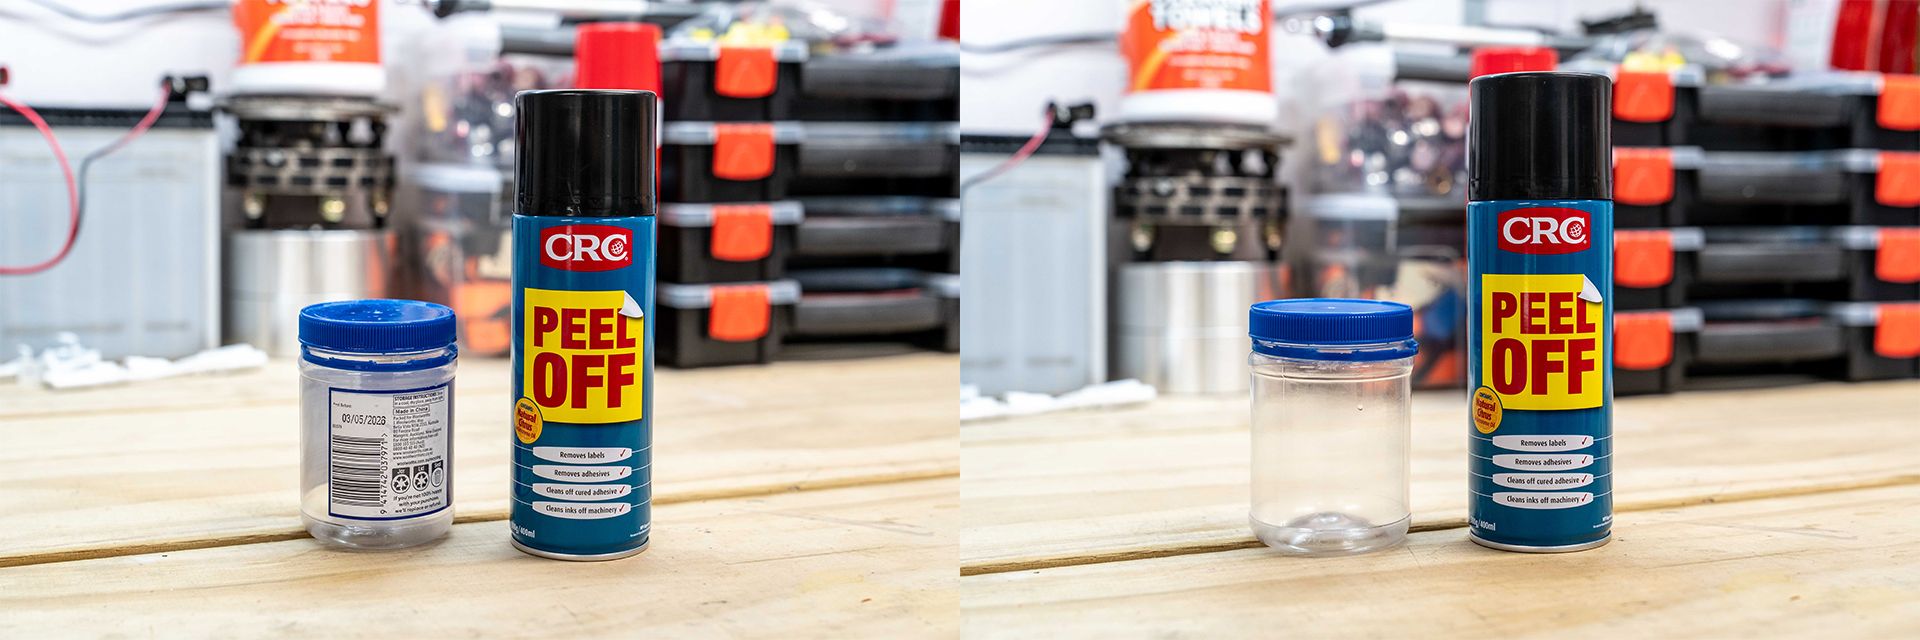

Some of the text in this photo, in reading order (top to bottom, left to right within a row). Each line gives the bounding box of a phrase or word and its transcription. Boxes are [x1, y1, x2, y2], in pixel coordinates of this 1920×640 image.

[1503, 216, 1586, 245] CRC
[545, 233, 628, 262] CRC
[1492, 291, 1596, 335] PEEL
[534, 305, 636, 350] PEEL
[1492, 337, 1596, 396] OFF
[533, 351, 636, 409] OFF
[1520, 439, 1567, 447] Removes labels
[380, 441, 388, 471] 037971
[559, 451, 606, 459] Removes labels
[1542, 458, 1572, 466] adhesives
[554, 469, 581, 477] Removes
[1506, 476, 1580, 485] Cleans off cured adhesive
[380, 474, 388, 504] 414742
[546, 486, 564, 495] Cleans
[565, 486, 574, 495] off
[574, 488, 592, 496] cured
[545, 504, 564, 513] Cleans
[564, 505, 577, 514] inks
[587, 506, 617, 514] machinery
[1506, 495, 1580, 504] Cleans inks off machinery
